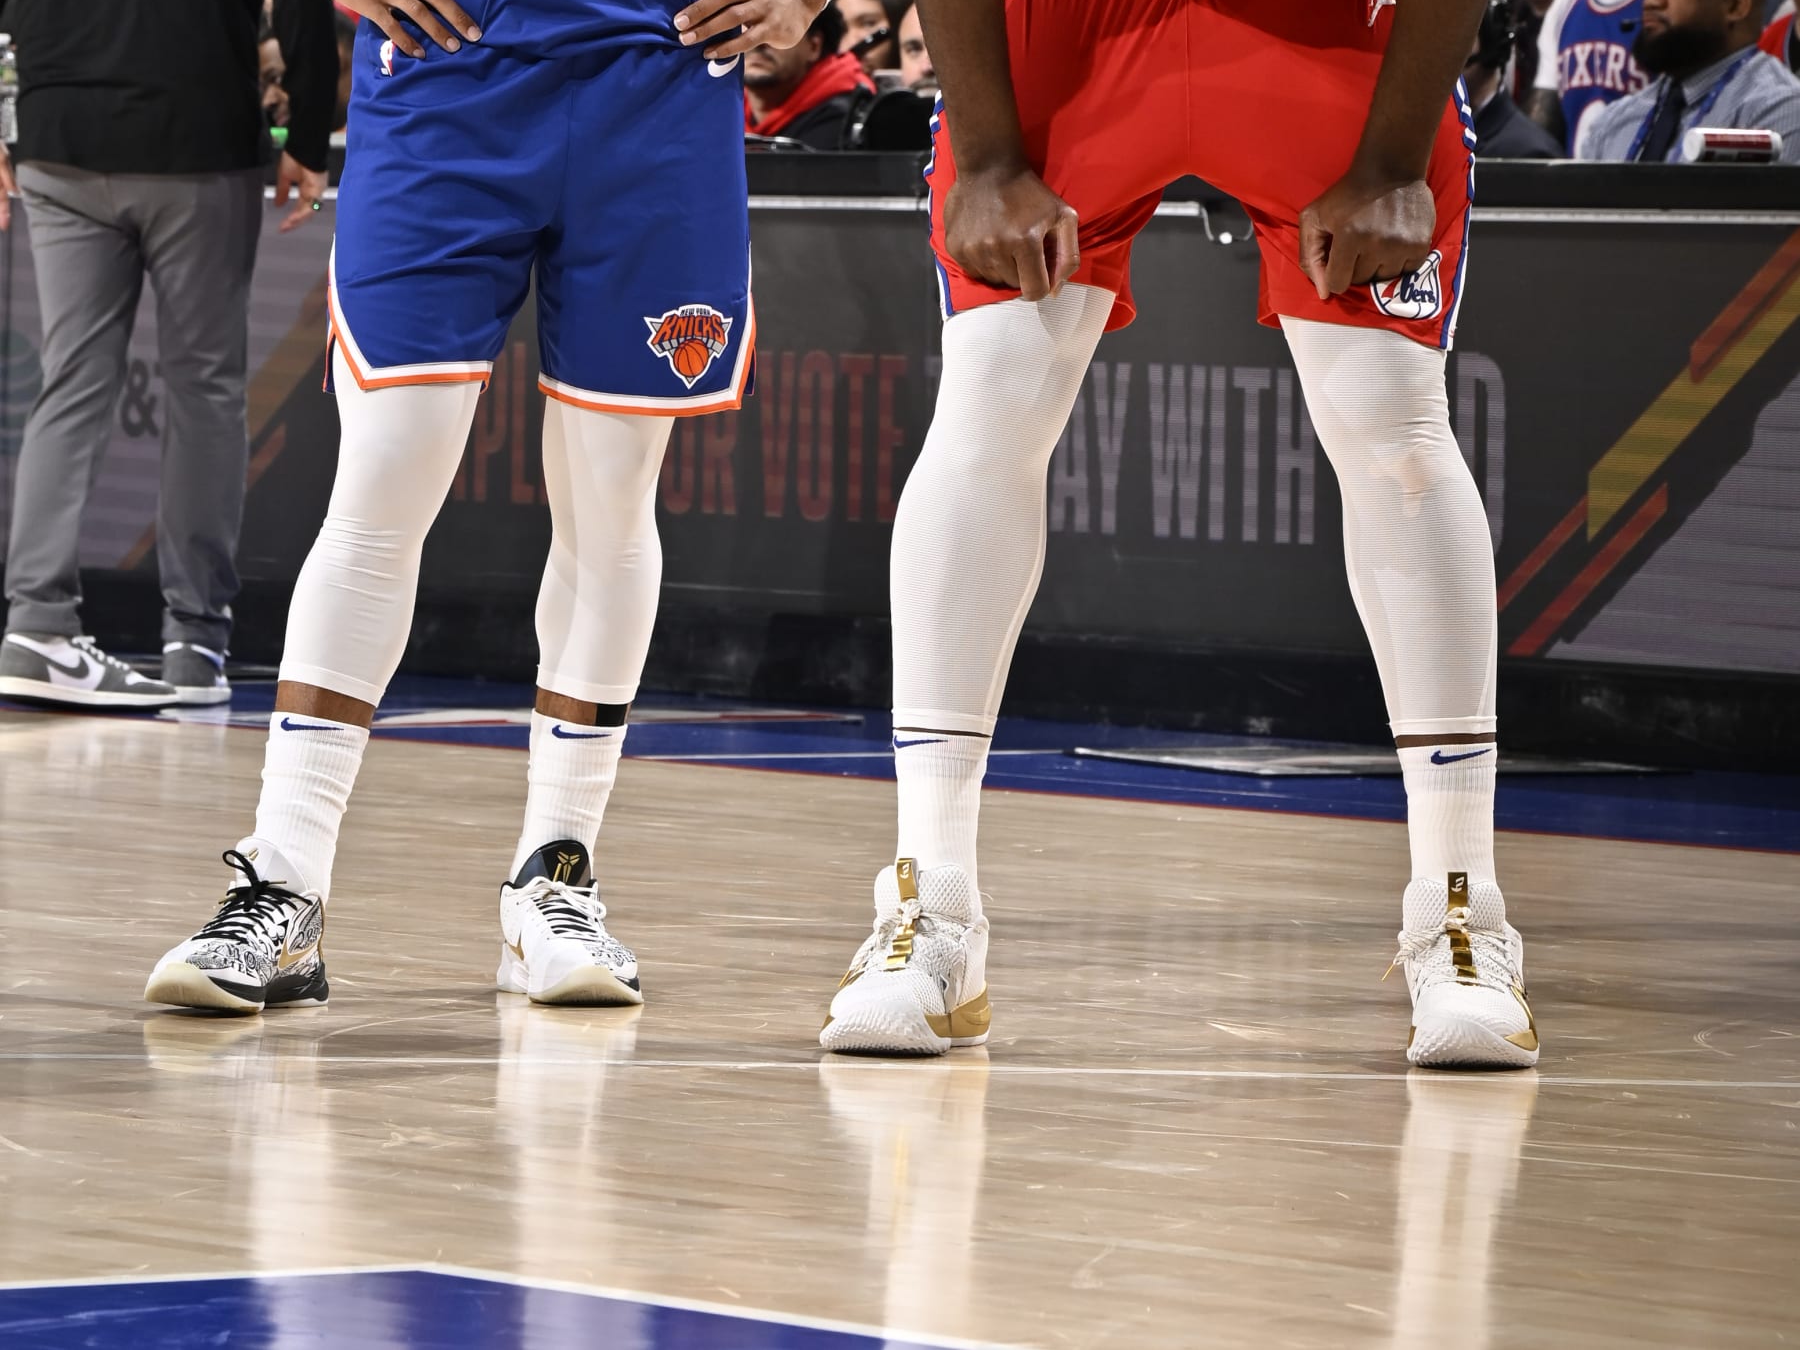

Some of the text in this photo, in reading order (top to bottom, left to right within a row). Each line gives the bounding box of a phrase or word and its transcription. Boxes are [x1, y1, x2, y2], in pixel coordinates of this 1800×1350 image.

[651, 313, 726, 346] KNICKS
[757, 349, 910, 523] VOTE
[1147, 363, 1317, 546] WITH
